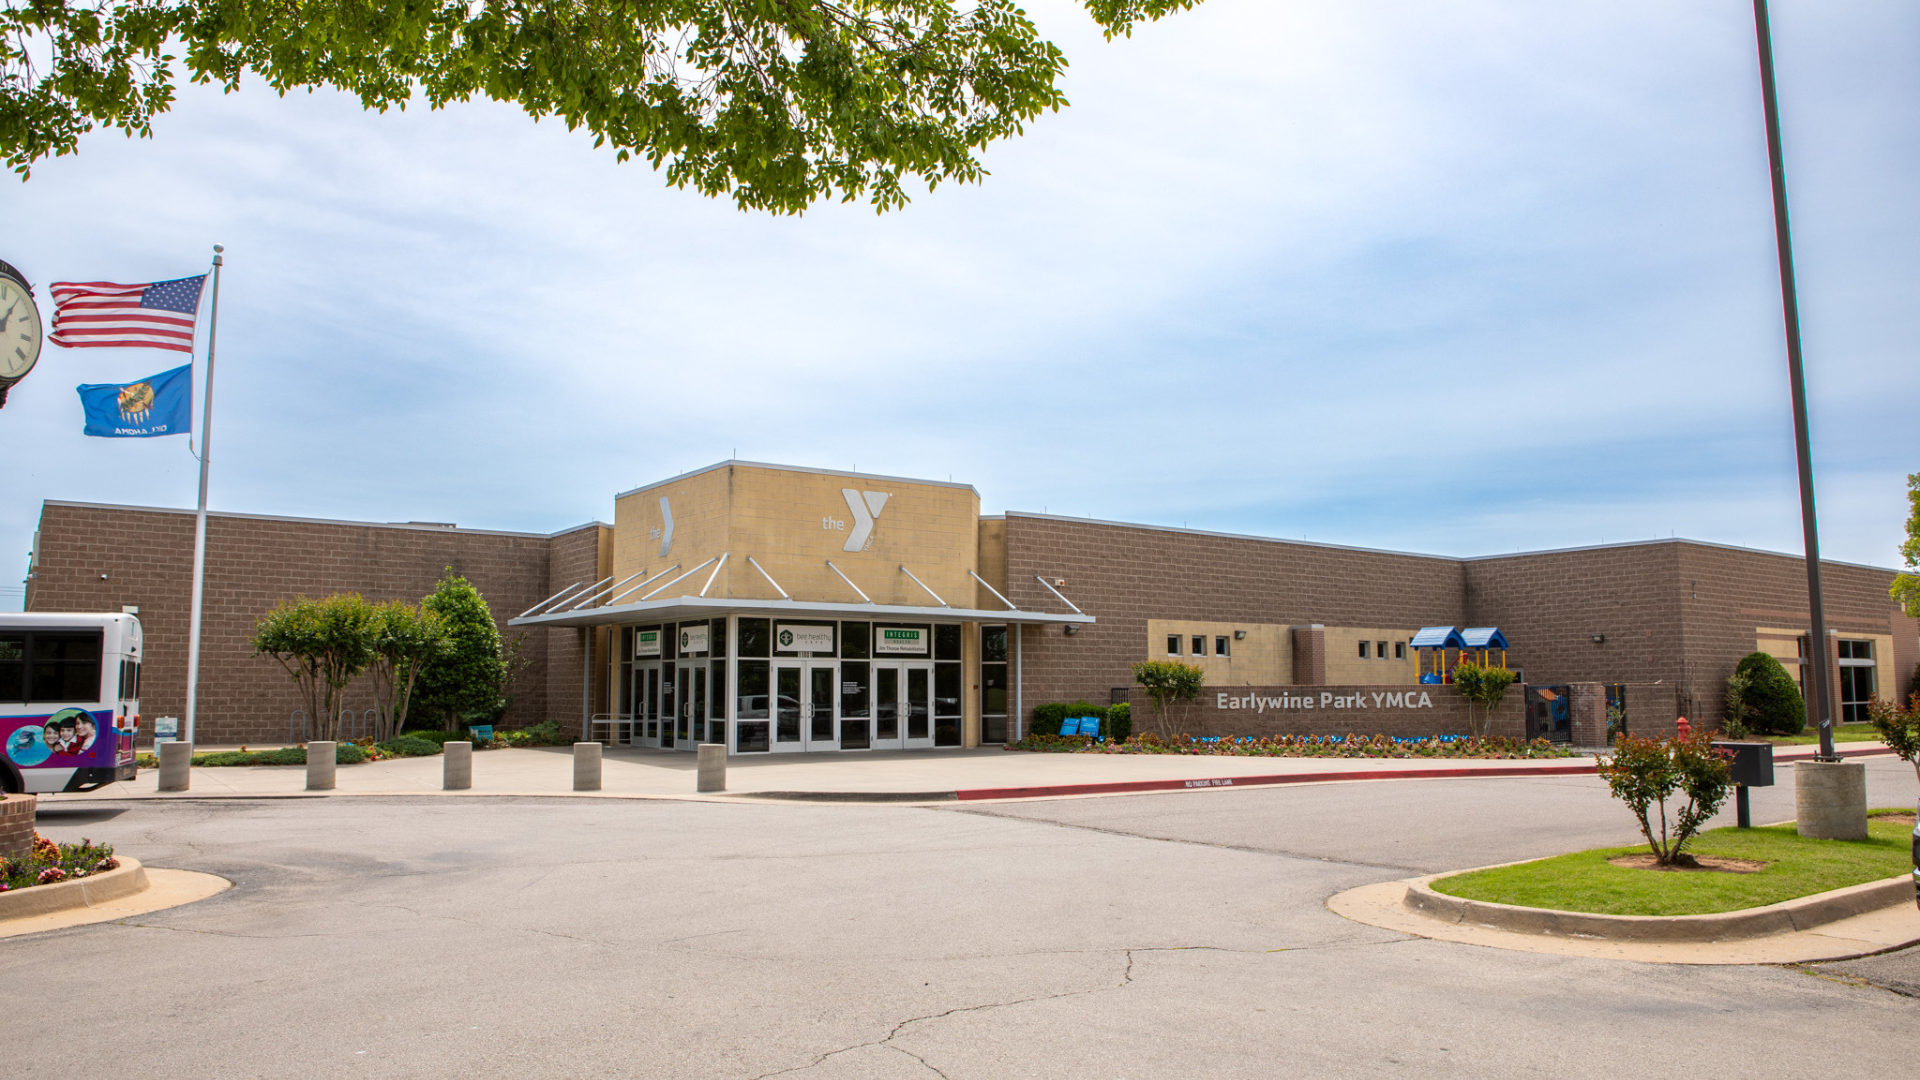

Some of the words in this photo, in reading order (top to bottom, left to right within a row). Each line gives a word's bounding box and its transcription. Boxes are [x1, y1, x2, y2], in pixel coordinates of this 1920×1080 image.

[822, 516, 844, 531] the
[863, 536, 874, 552] YMCA
[808, 633, 831, 642] healthy
[1217, 691, 1314, 713] Earlywine
[1320, 691, 1367, 709] Park
[1371, 691, 1433, 708] YMCA
